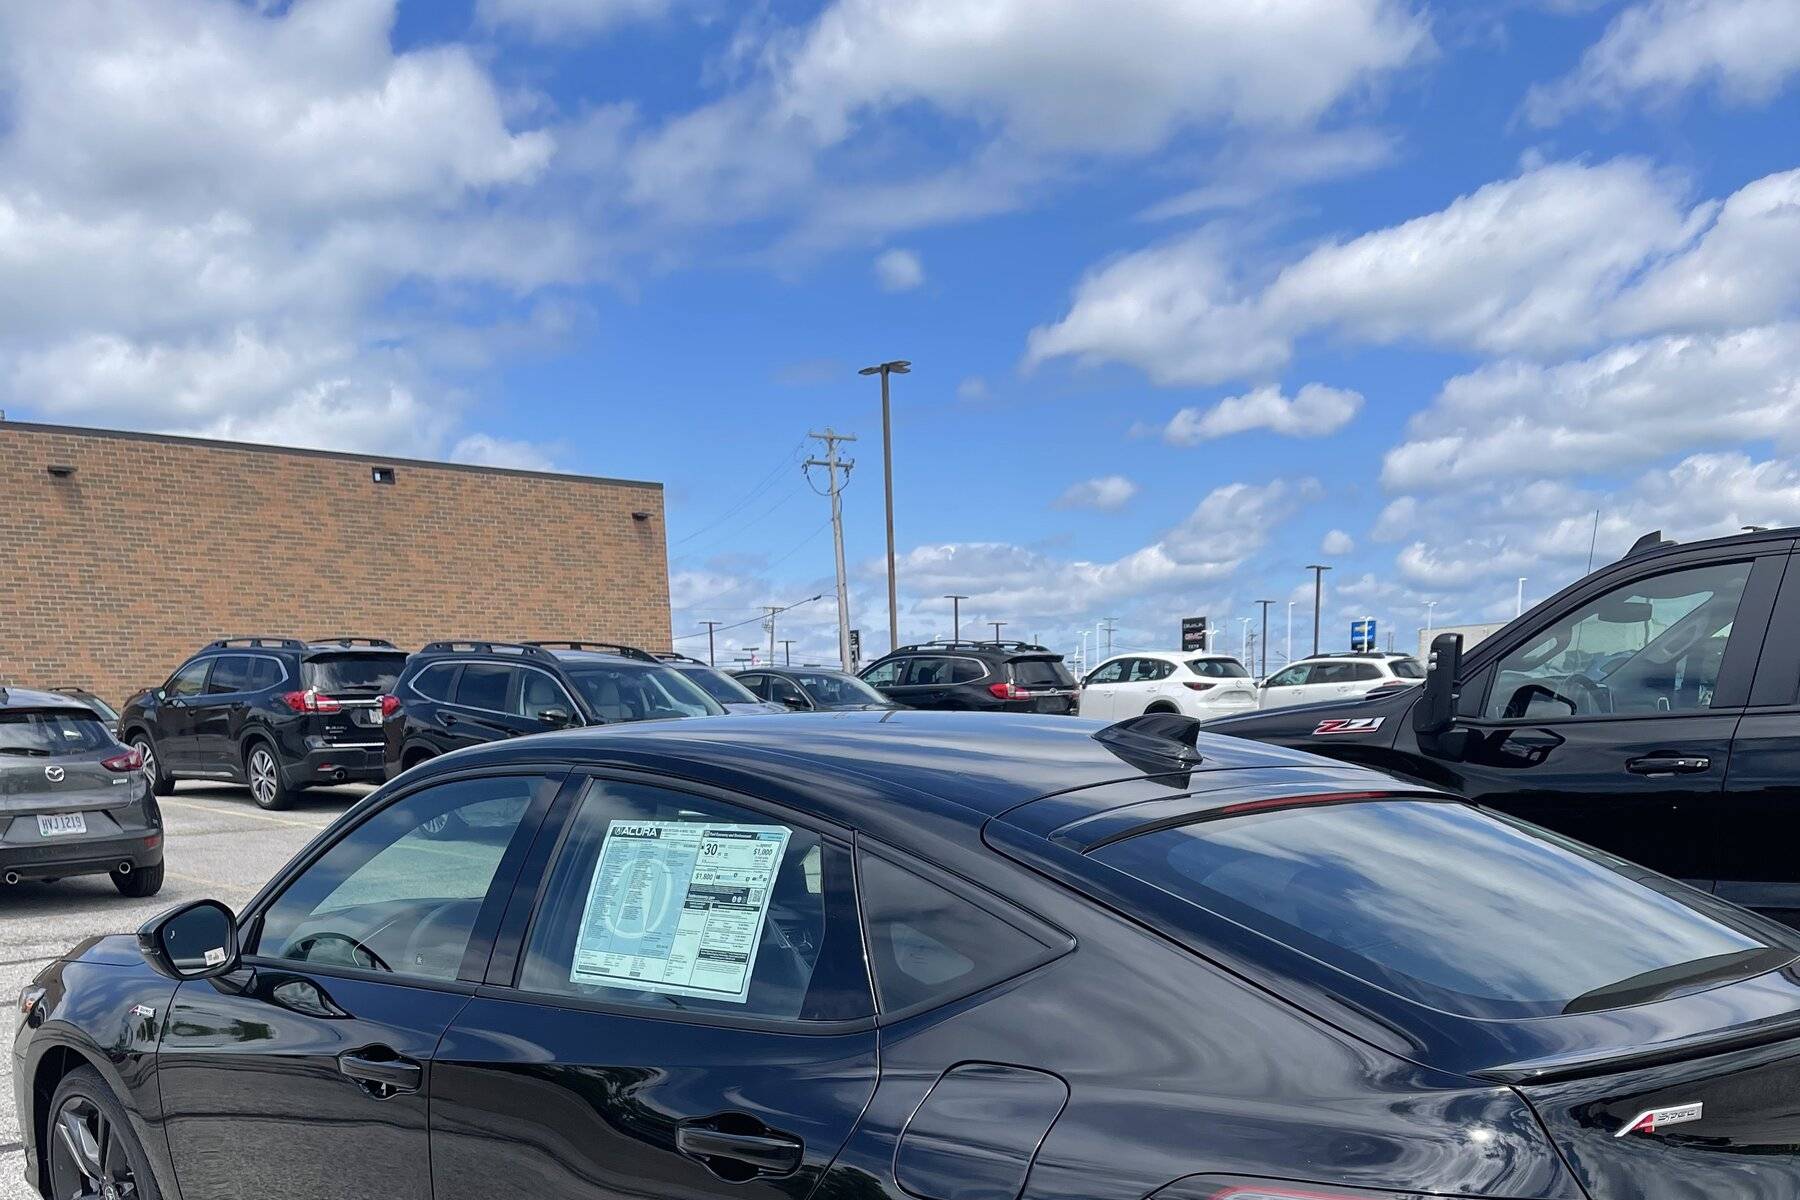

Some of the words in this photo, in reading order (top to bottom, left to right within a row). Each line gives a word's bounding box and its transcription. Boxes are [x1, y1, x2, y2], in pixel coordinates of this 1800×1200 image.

[1312, 716, 1386, 735] Z71
[621, 826, 658, 837] ACURA
[704, 843, 719, 856] 30
